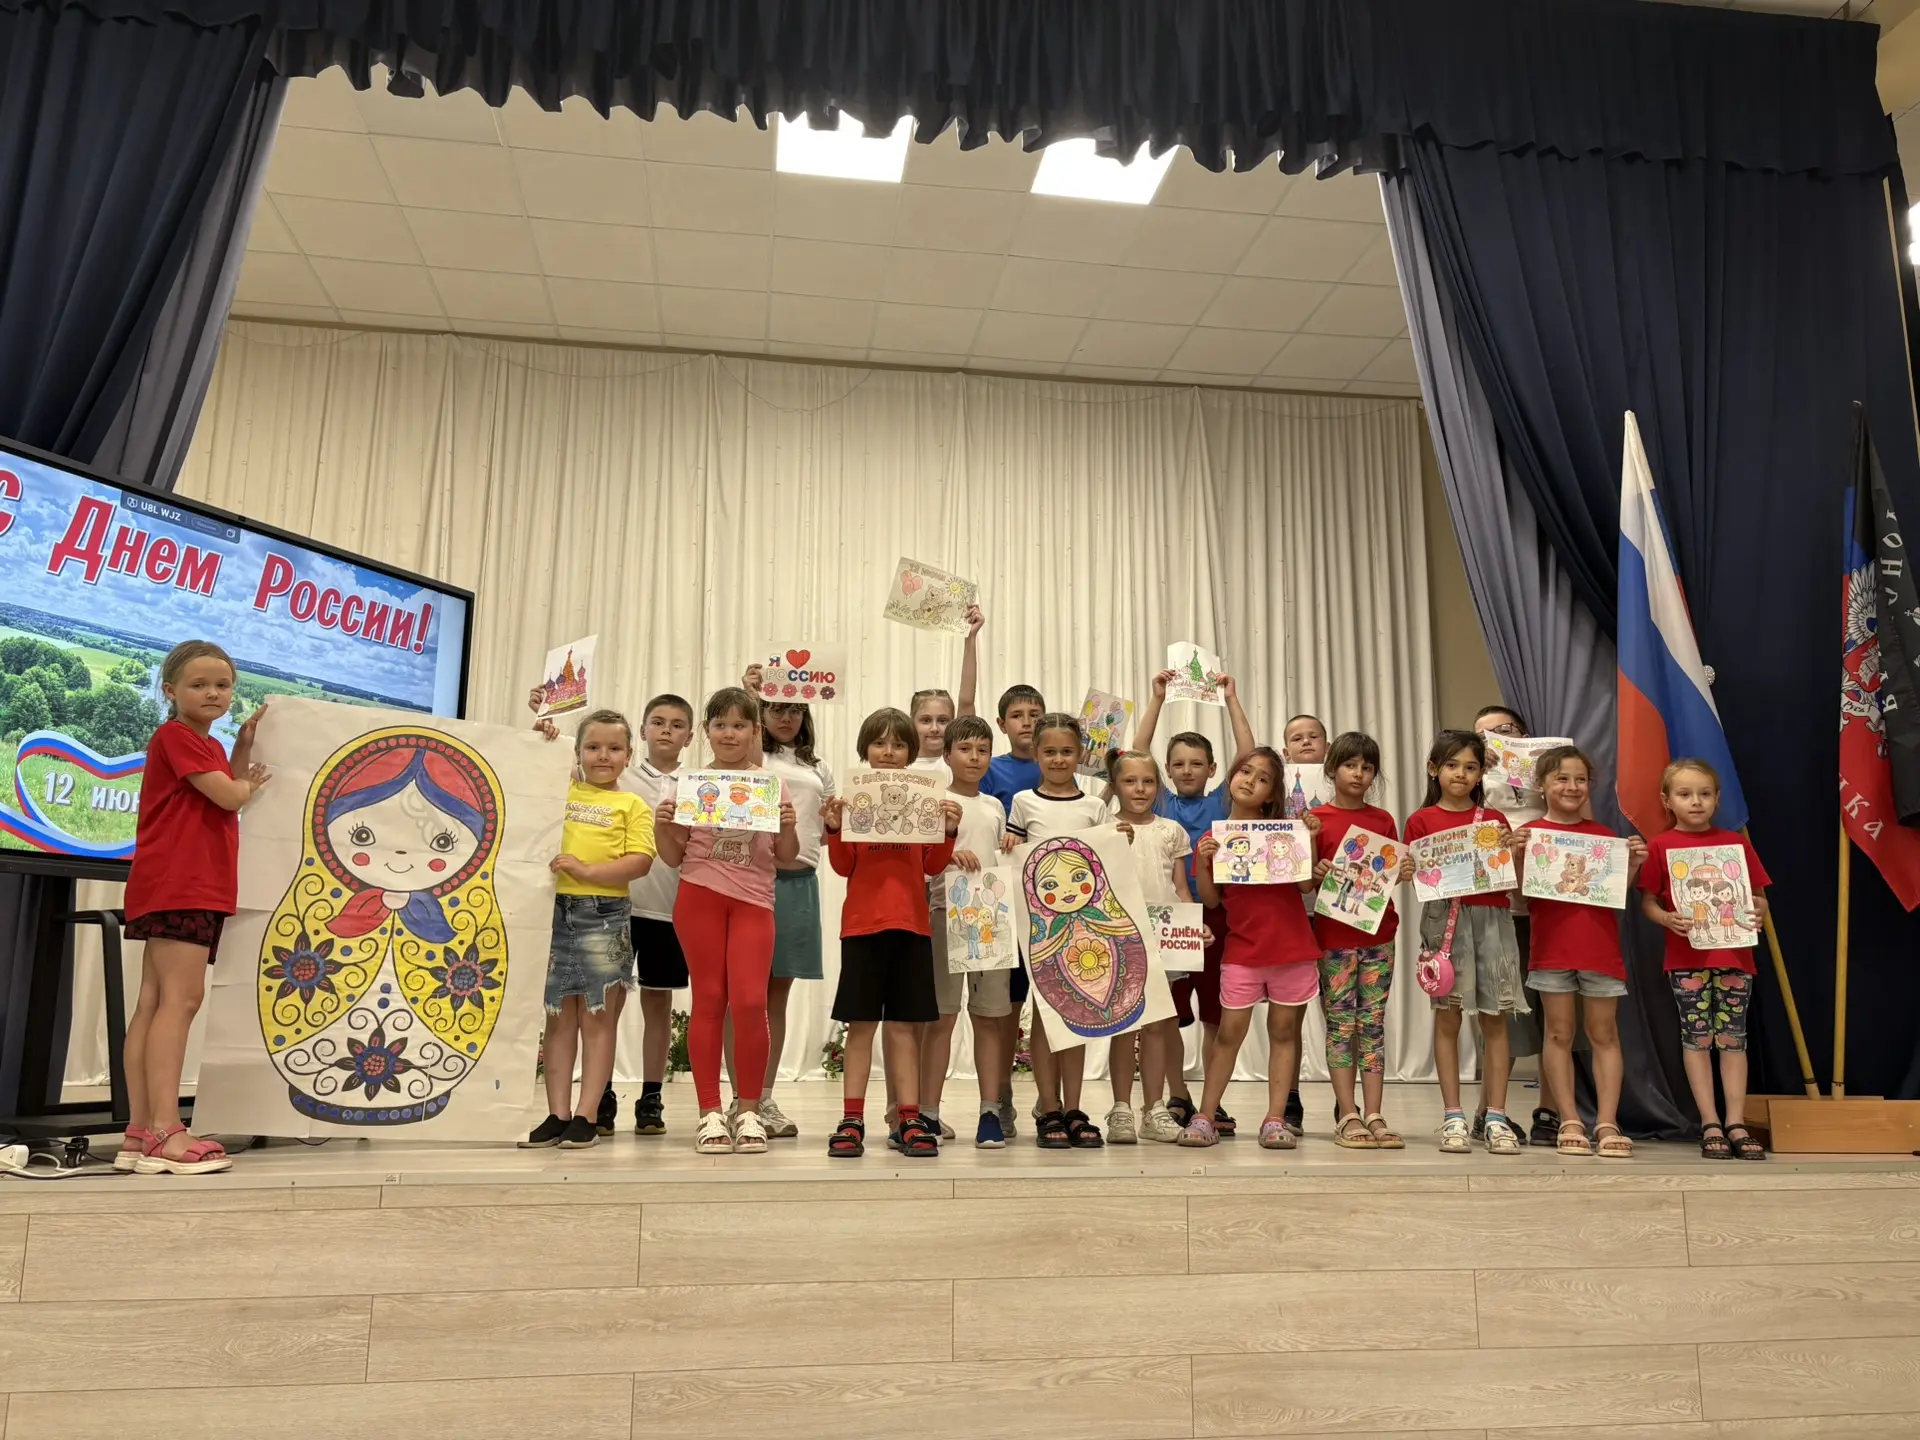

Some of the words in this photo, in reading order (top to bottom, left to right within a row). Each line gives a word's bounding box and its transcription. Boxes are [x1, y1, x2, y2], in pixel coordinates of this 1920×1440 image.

[140, 501, 159, 515] U8L
[161, 507, 181, 521] WJZ
[46, 495, 223, 597] Днем
[252, 551, 434, 655] России!
[768, 653, 781, 667] Я
[766, 668, 836, 684] РОССИЮ
[852, 775, 861, 786] С
[45, 770, 75, 806] 12
[1251, 823, 1294, 832] РОССИЯ
[722, 840, 743, 854] BE
[1420, 849, 1429, 858] С
[1161, 927, 1169, 937] С
[1170, 925, 1200, 939] ДНЁМ
[1160, 940, 1201, 951] РОССИИ
